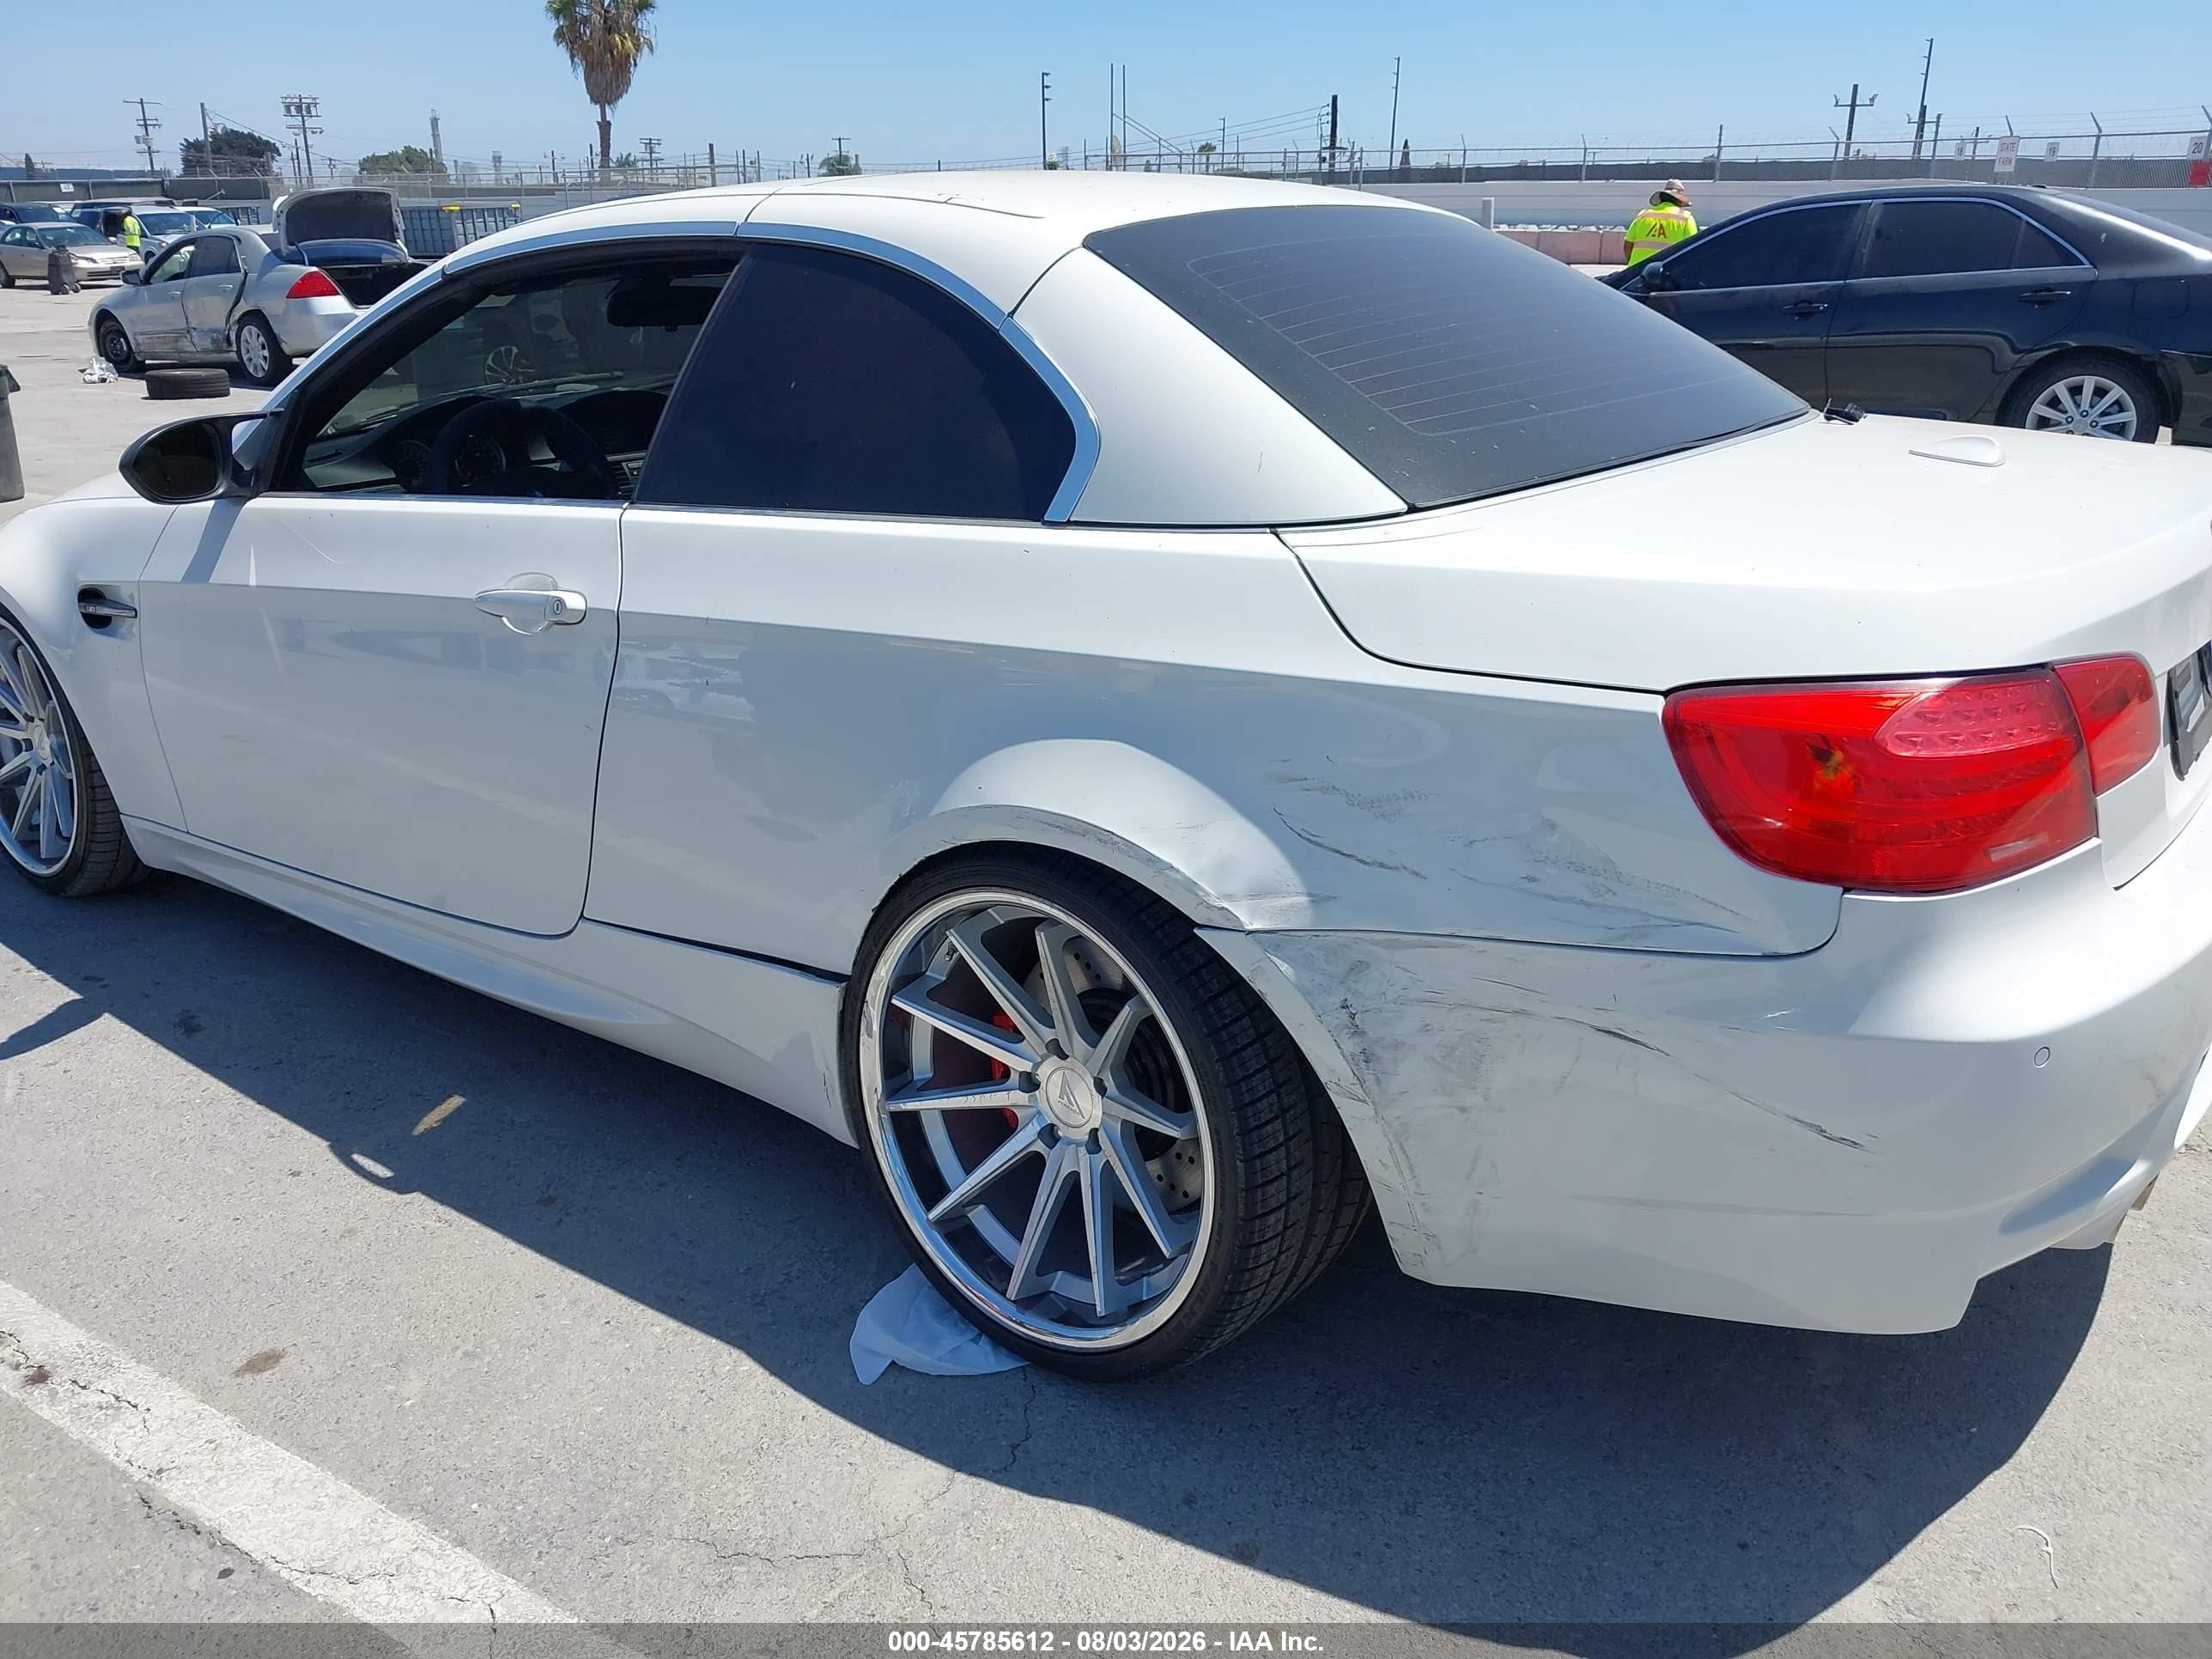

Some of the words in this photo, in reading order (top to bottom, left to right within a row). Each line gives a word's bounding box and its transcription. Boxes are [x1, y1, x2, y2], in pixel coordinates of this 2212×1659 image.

[1957, 147, 1964, 157] 18
[2000, 143, 2016, 152] STATE
[2049, 147, 2056, 157] 19
[2191, 143, 2203, 154] 20
